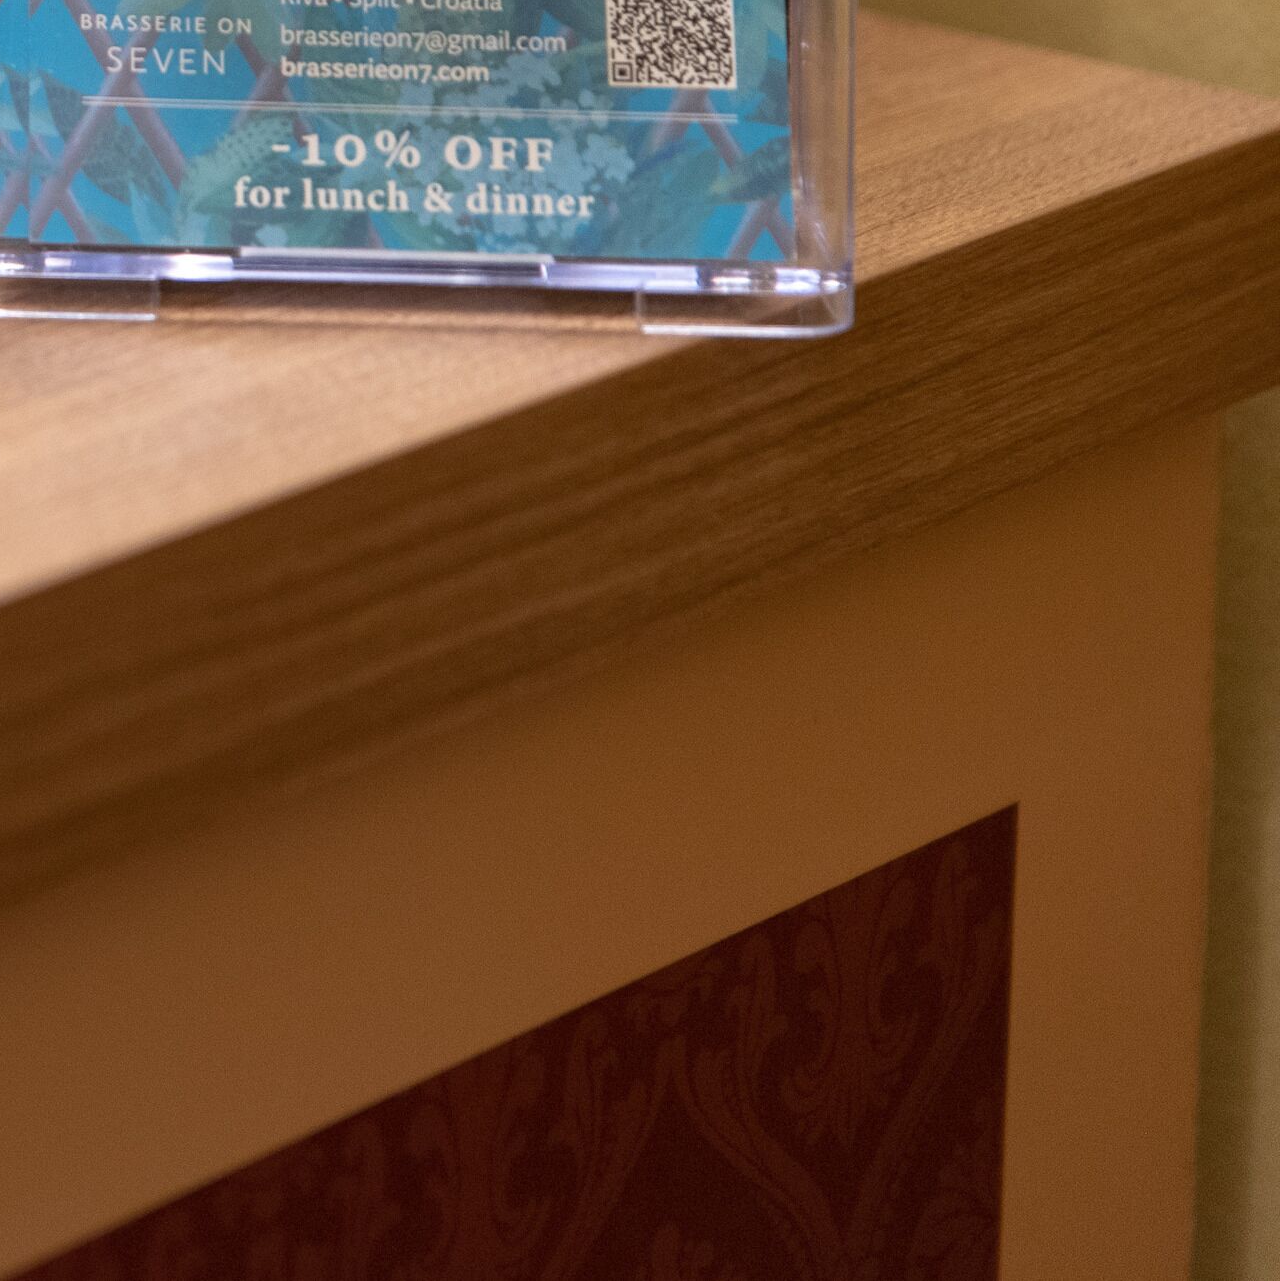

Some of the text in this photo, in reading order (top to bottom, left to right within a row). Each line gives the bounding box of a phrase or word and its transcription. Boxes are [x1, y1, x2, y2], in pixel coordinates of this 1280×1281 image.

[79, 13, 252, 35] BRASSERIE ON
[280, 24, 567, 55] brasserieon7@gmail.com
[106, 46, 226, 75] SEVEN
[280, 56, 489, 84] brasserieon7.com
[271, 129, 554, 172] -10% OFF
[233, 175, 595, 217] for lunch & dinner
